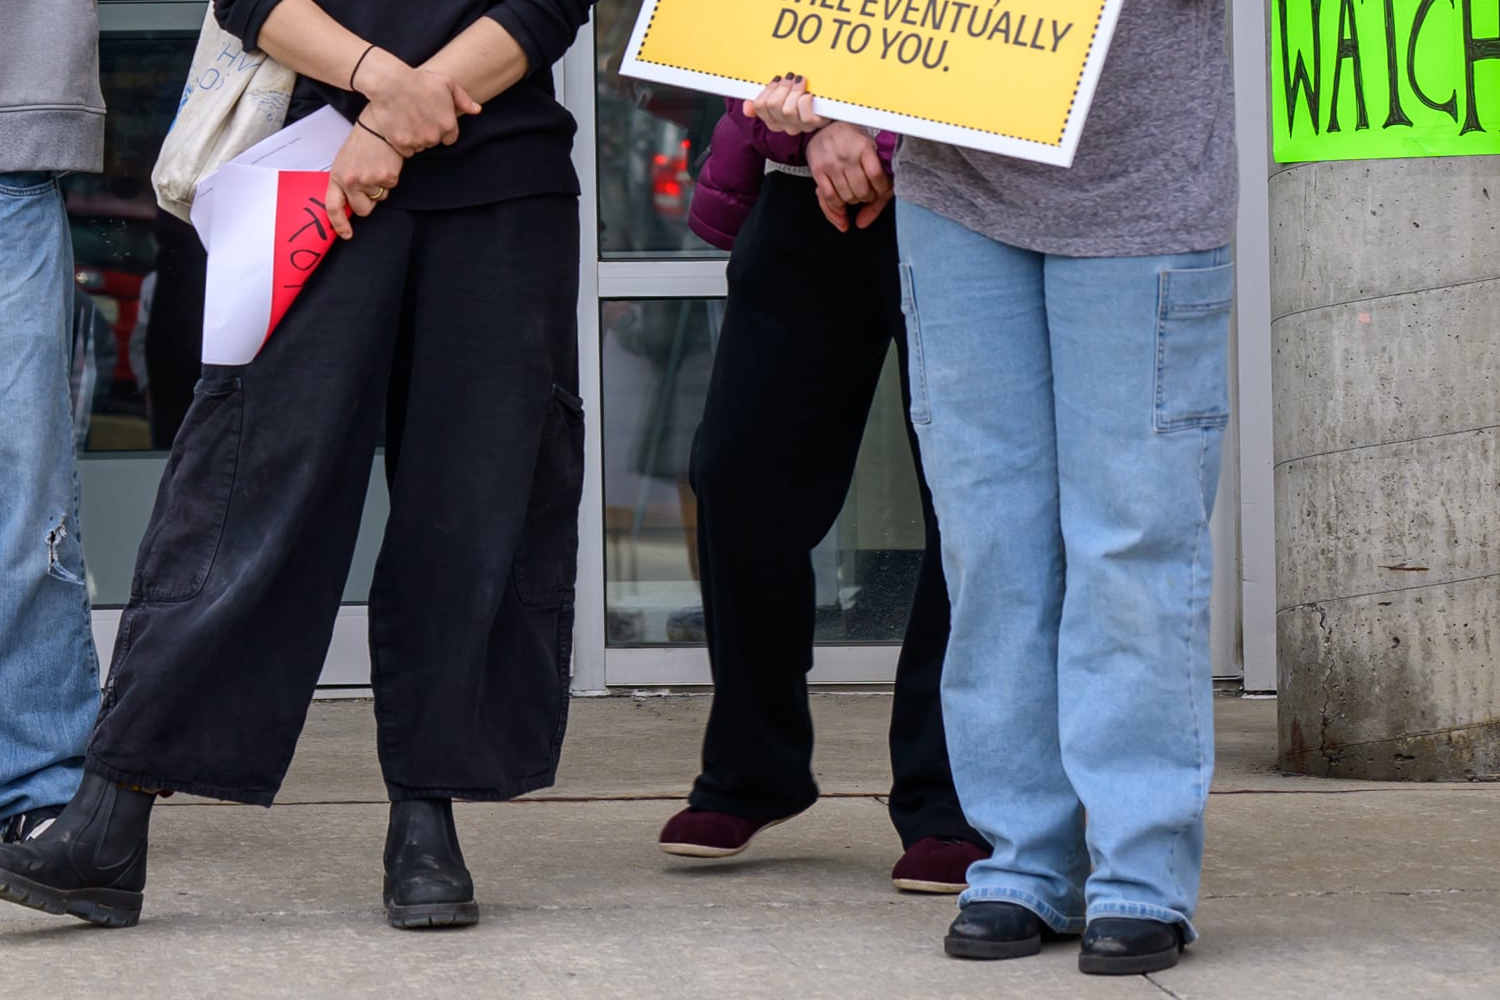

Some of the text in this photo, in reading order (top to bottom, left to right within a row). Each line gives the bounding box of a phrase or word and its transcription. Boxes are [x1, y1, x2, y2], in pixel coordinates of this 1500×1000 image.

[771, 7, 950, 73] DO TO YOU.
